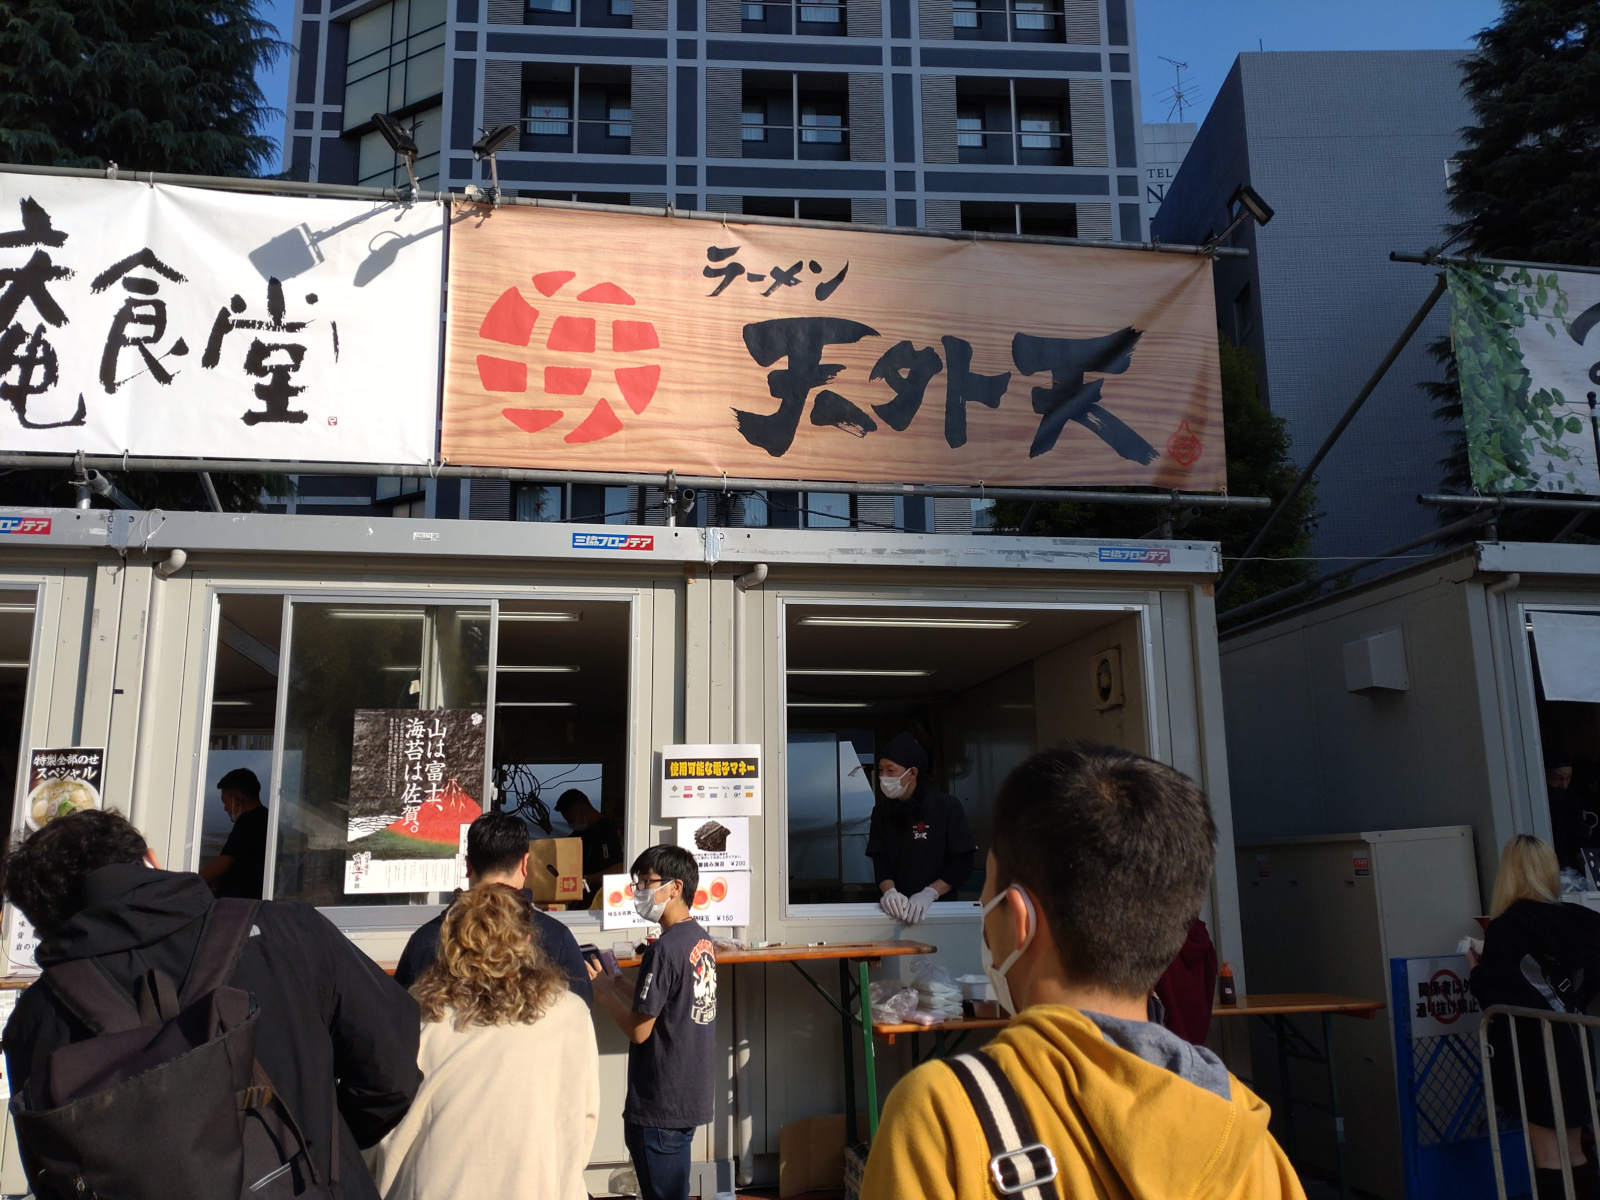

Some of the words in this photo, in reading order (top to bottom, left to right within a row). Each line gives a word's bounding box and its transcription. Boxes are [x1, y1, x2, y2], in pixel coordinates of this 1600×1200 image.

[702, 246, 850, 301] ラーメン
[731, 316, 1161, 466] 天外天
[573, 535, 652, 548] 三協フロンテア
[1100, 549, 1168, 561] 三協フロンテア
[33, 753, 100, 767] 特製全部のせ
[424, 718, 447, 812] 山は富士、
[35, 766, 98, 780] スペシャル
[400, 717, 427, 833] 海苔は佐賀。
[670, 760, 756, 777] 使用可能な電子マネー
[717, 914, 734, 922] ¥150
